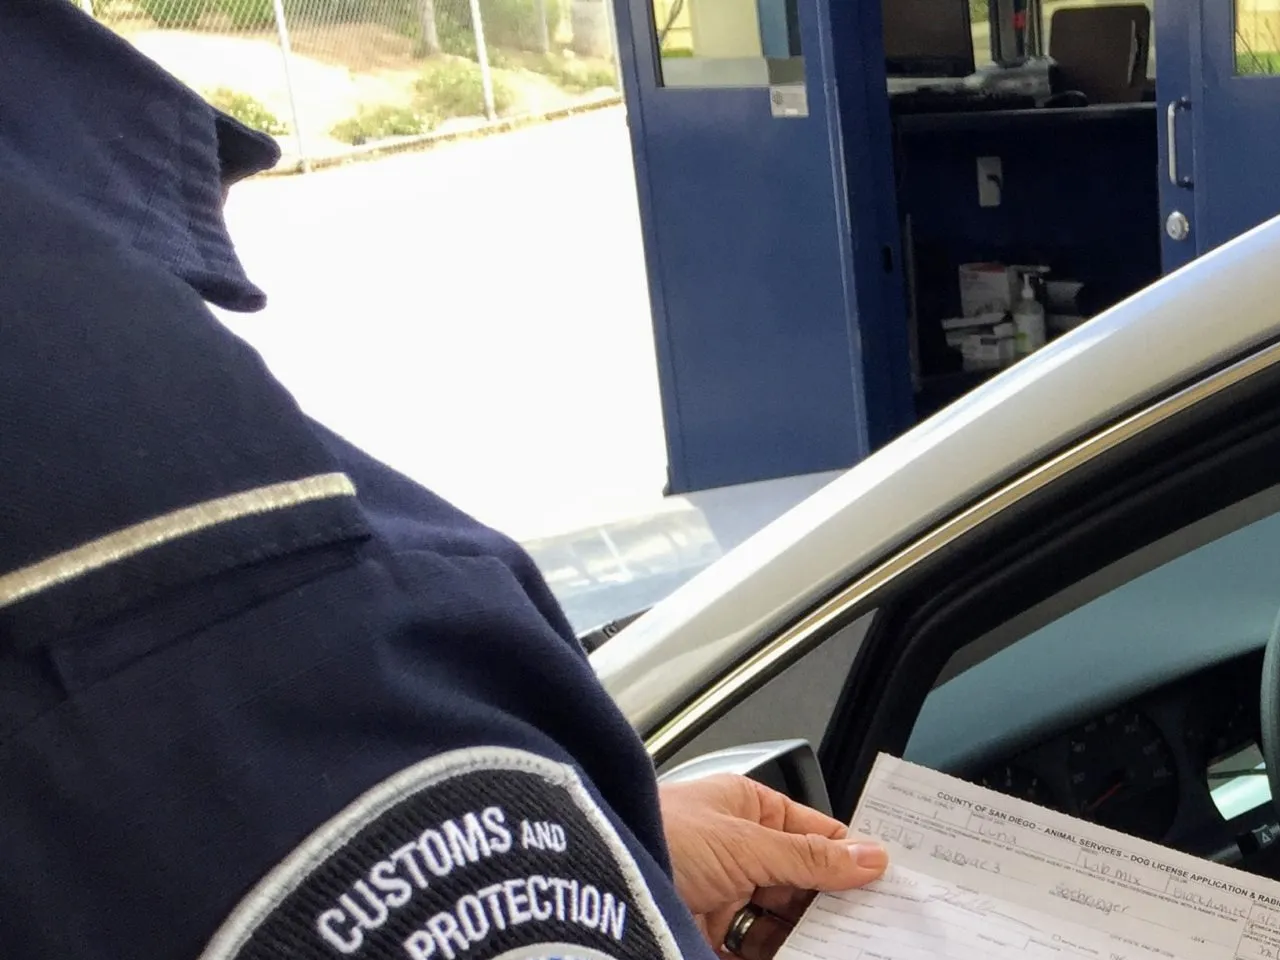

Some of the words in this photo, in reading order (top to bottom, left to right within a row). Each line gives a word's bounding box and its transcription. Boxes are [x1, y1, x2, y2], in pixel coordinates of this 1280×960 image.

[316, 806, 512, 954] CUSTOMS
[521, 819, 567, 852] AND
[936, 790, 974, 809] COUNTY
[973, 803, 987, 813] OF
[987, 807, 1007, 820] SAN
[1007, 814, 1036, 830] DIEGO
[1043, 826, 1077, 843] ANIMAL
[1078, 837, 1122, 857] SERVICES
[1129, 853, 1150, 866] DOG
[1151, 860, 1189, 878] LICENSE
[1189, 872, 1248, 896] APPLICATION
[1249, 891, 1256, 899] &
